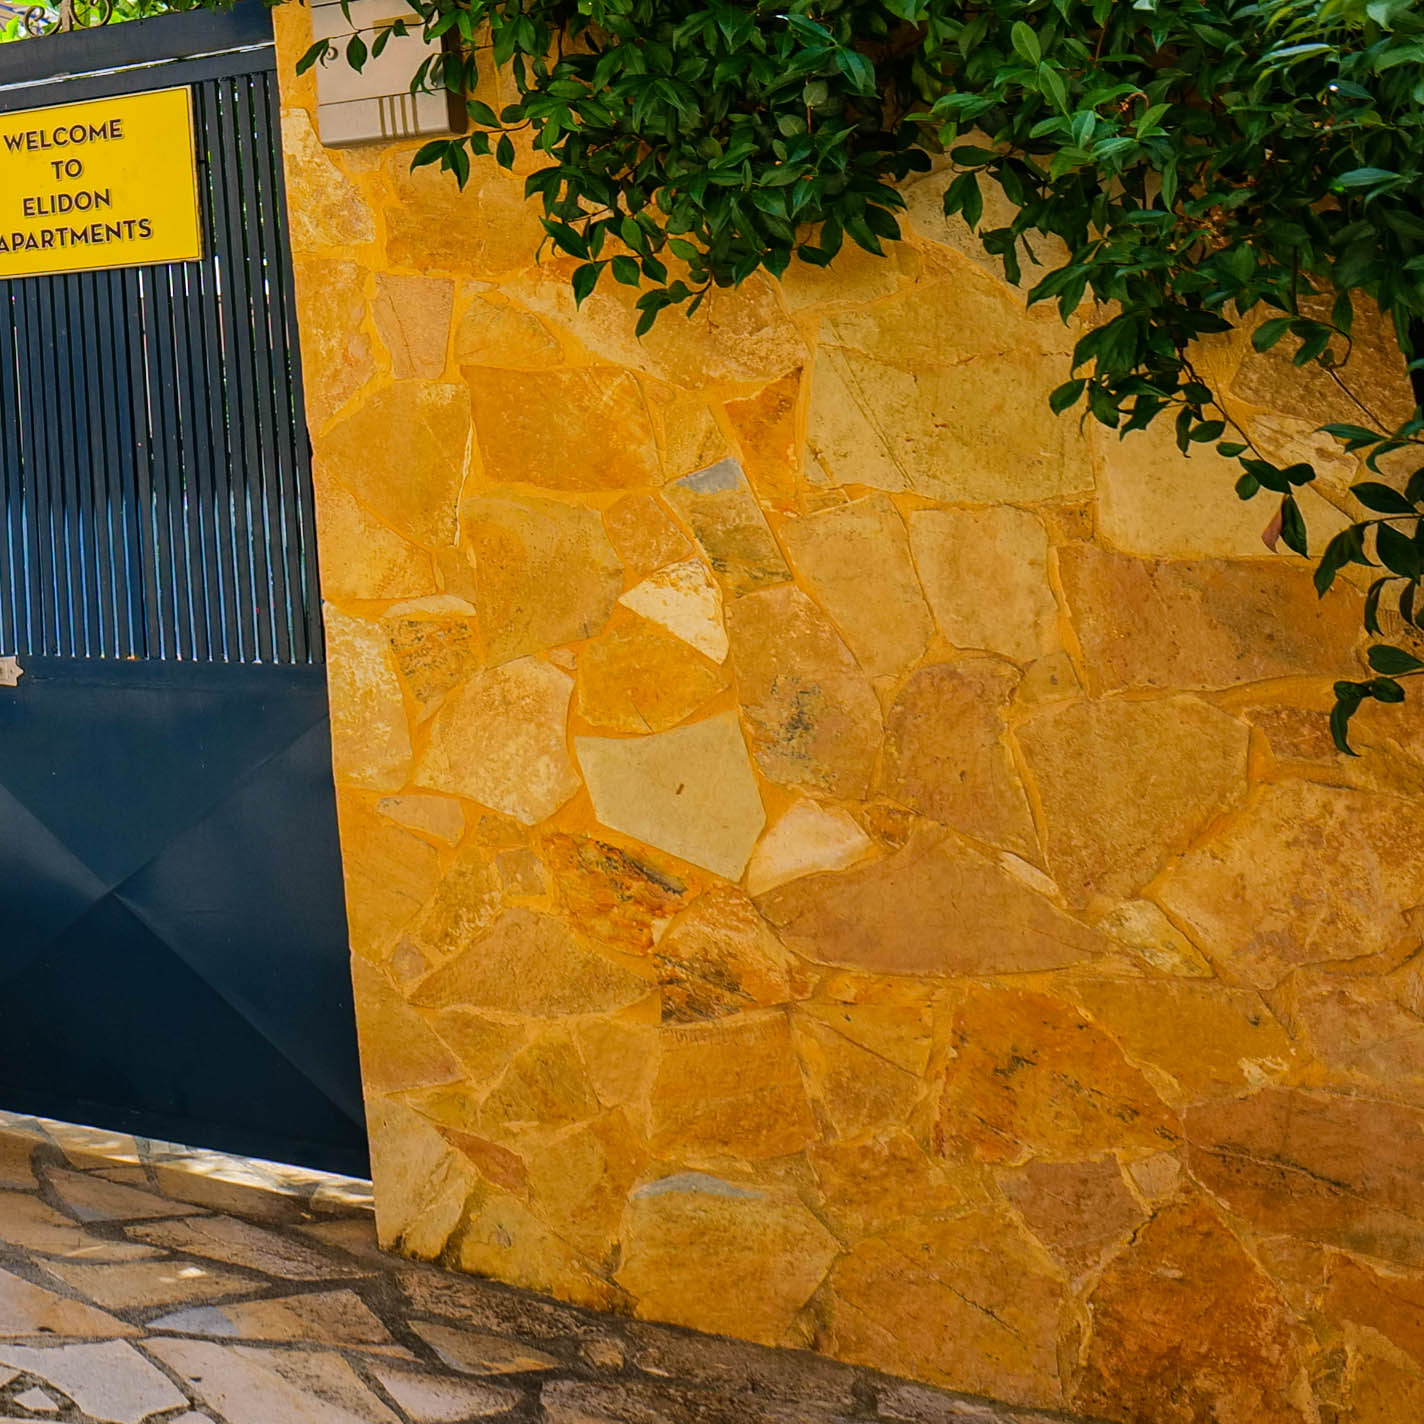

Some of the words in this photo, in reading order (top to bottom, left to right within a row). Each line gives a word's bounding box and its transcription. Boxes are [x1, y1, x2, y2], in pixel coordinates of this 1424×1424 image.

[2, 118, 123, 152] WELCOME
[50, 158, 83, 180] TO
[22, 188, 111, 217] ELIDON
